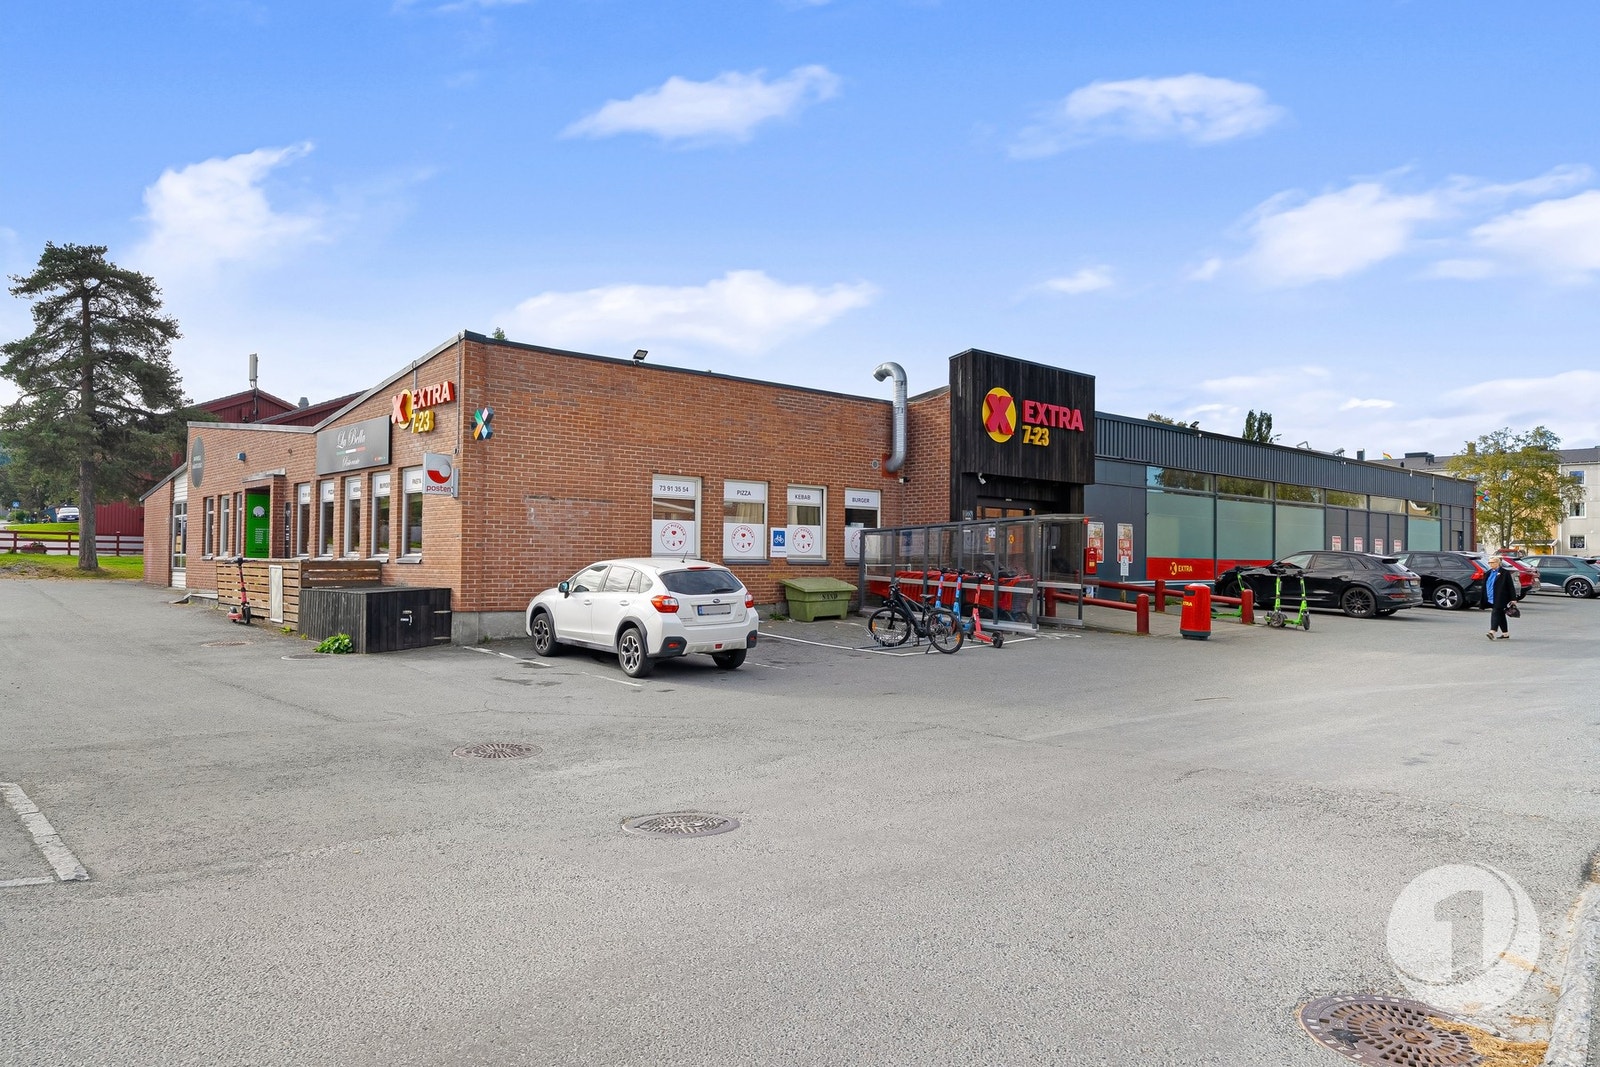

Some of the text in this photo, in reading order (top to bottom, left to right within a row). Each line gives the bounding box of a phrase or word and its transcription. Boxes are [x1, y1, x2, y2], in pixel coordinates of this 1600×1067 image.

[411, 381, 454, 410] EXTRA
[411, 410, 434, 434] 7-23
[1022, 400, 1084, 431] EXTRA
[1022, 425, 1050, 447] 7-23
[426, 485, 452, 493] posten
